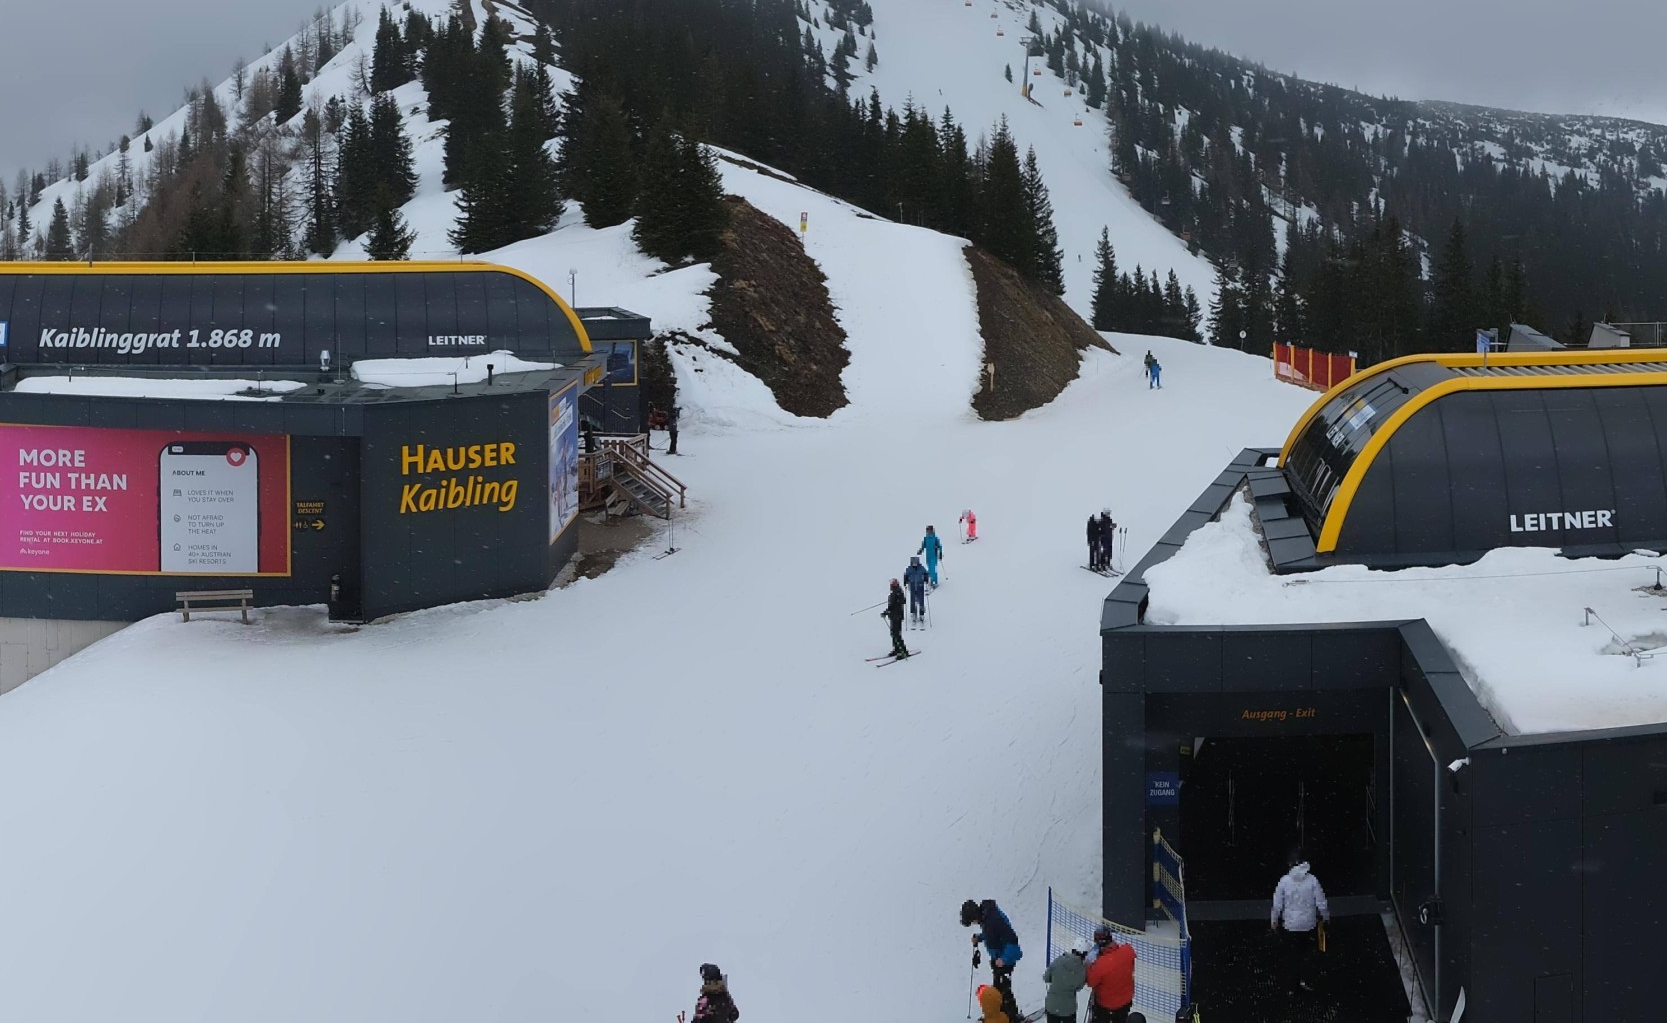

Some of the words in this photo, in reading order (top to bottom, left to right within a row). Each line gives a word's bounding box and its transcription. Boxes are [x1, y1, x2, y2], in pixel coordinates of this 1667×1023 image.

[39, 328, 181, 354] Kaiblinggrat
[186, 329, 253, 348] 1.868
[258, 333, 281, 348] m
[428, 335, 486, 345] LEITNER
[19, 449, 86, 467] MORE
[402, 442, 516, 475] HAUSER
[19, 472, 60, 488] FUN
[68, 473, 127, 490] THAN
[20, 494, 76, 511] YOUR
[82, 496, 108, 512] EX
[400, 478, 518, 514] Kaibling
[1510, 509, 1615, 532] LEITNER
[28, 548, 50, 556] keyone
[1242, 709, 1287, 721] Ausgang
[1296, 707, 1316, 717] Exit
